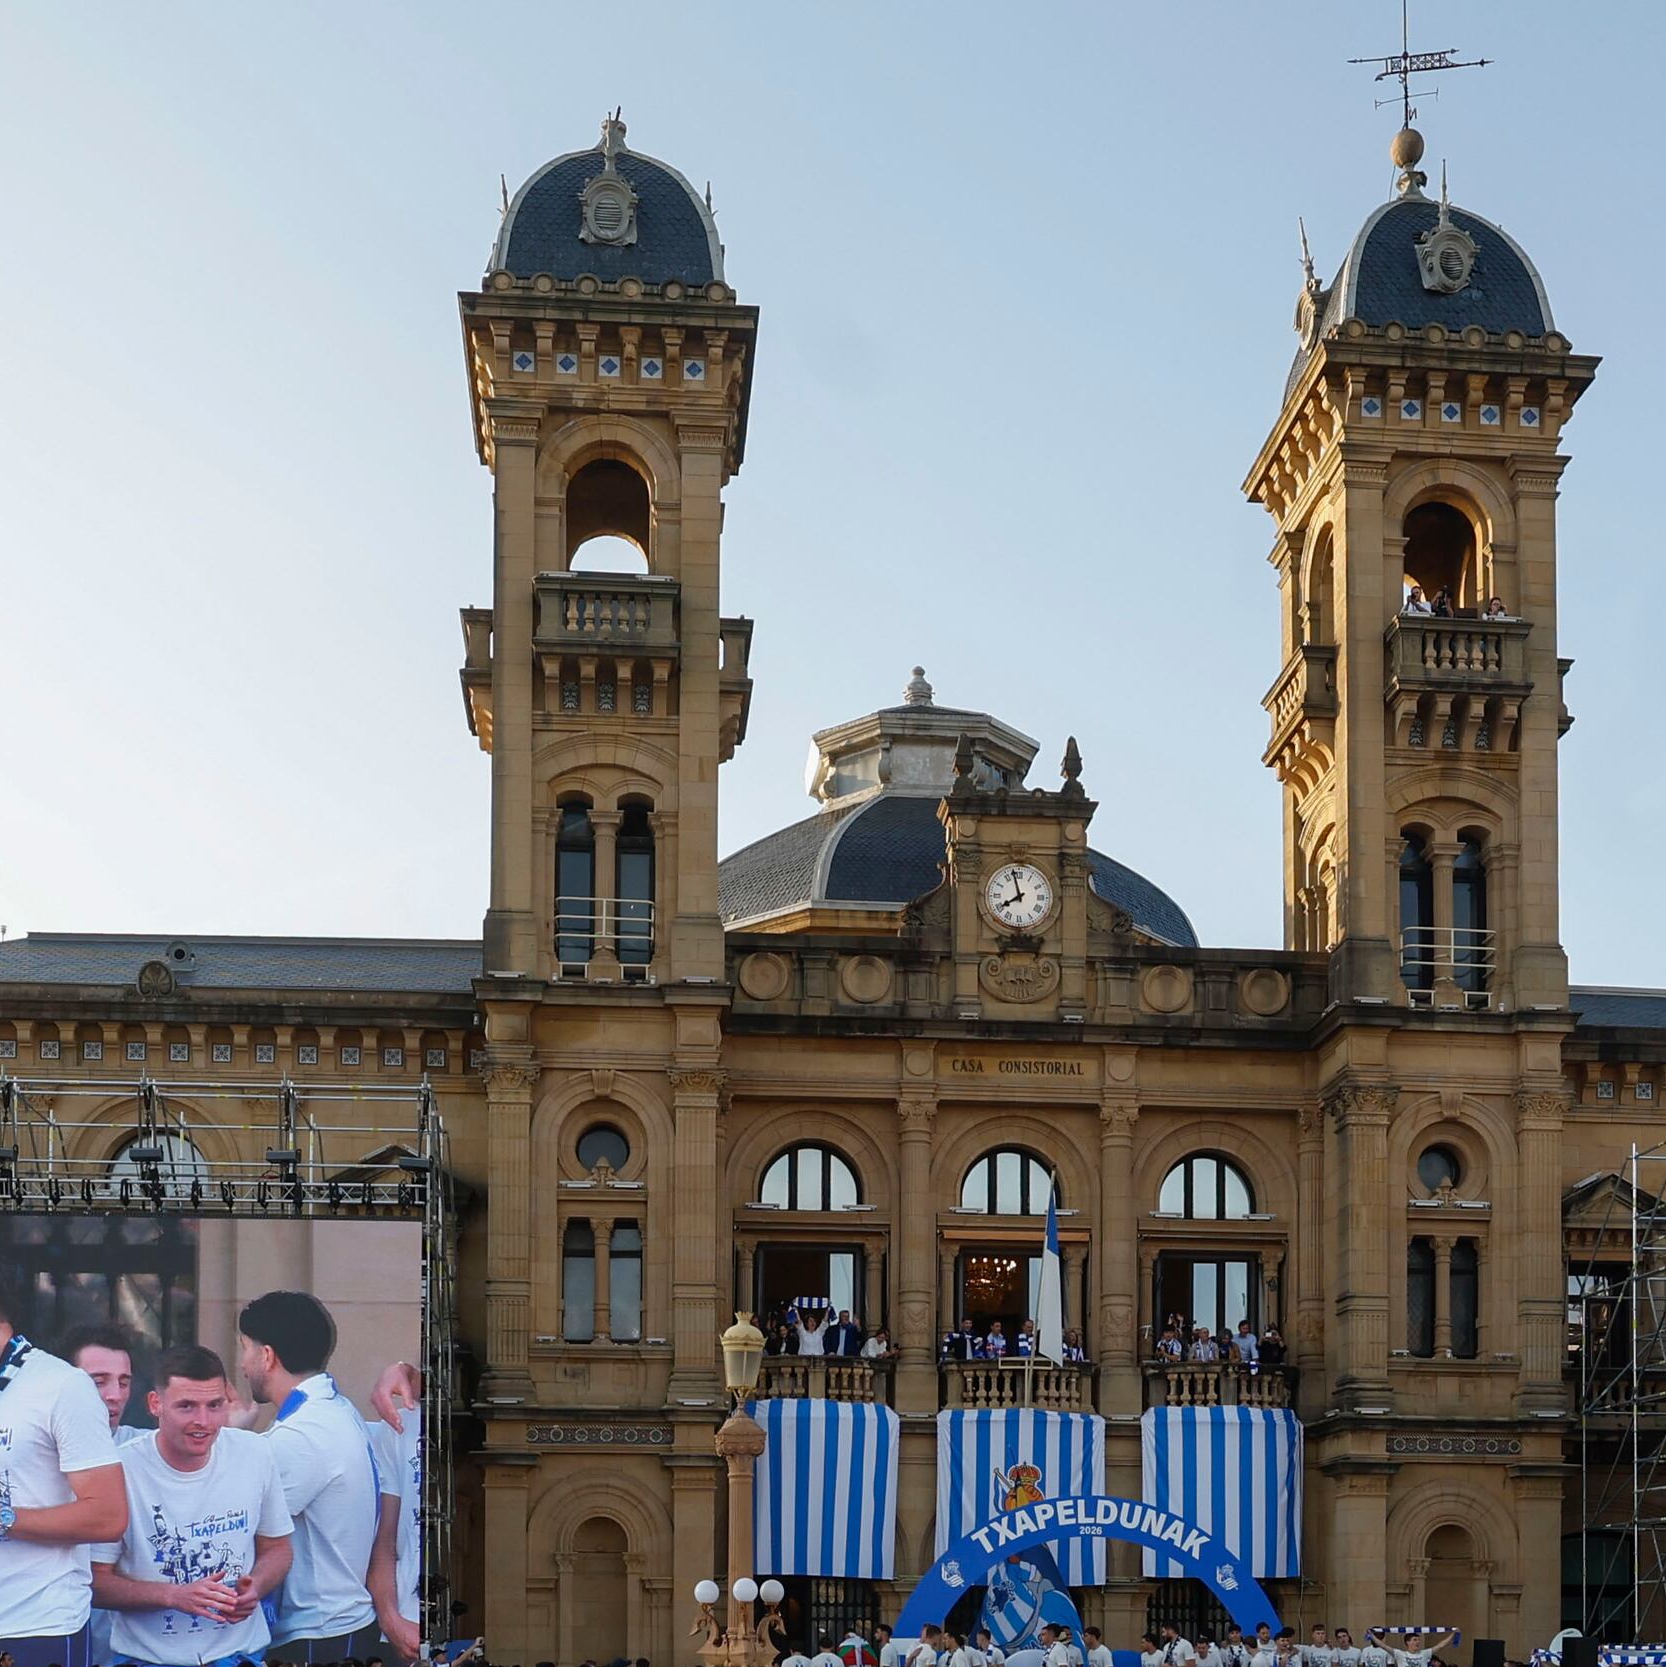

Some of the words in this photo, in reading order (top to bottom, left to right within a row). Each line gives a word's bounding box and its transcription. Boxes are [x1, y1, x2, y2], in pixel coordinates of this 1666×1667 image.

[951, 1059, 985, 1074] CASA
[998, 1060, 1085, 1077] CONSISTORIAL
[970, 1497, 1211, 1561] TXAPELDUNAK
[1079, 1525, 1103, 1536] 2026
